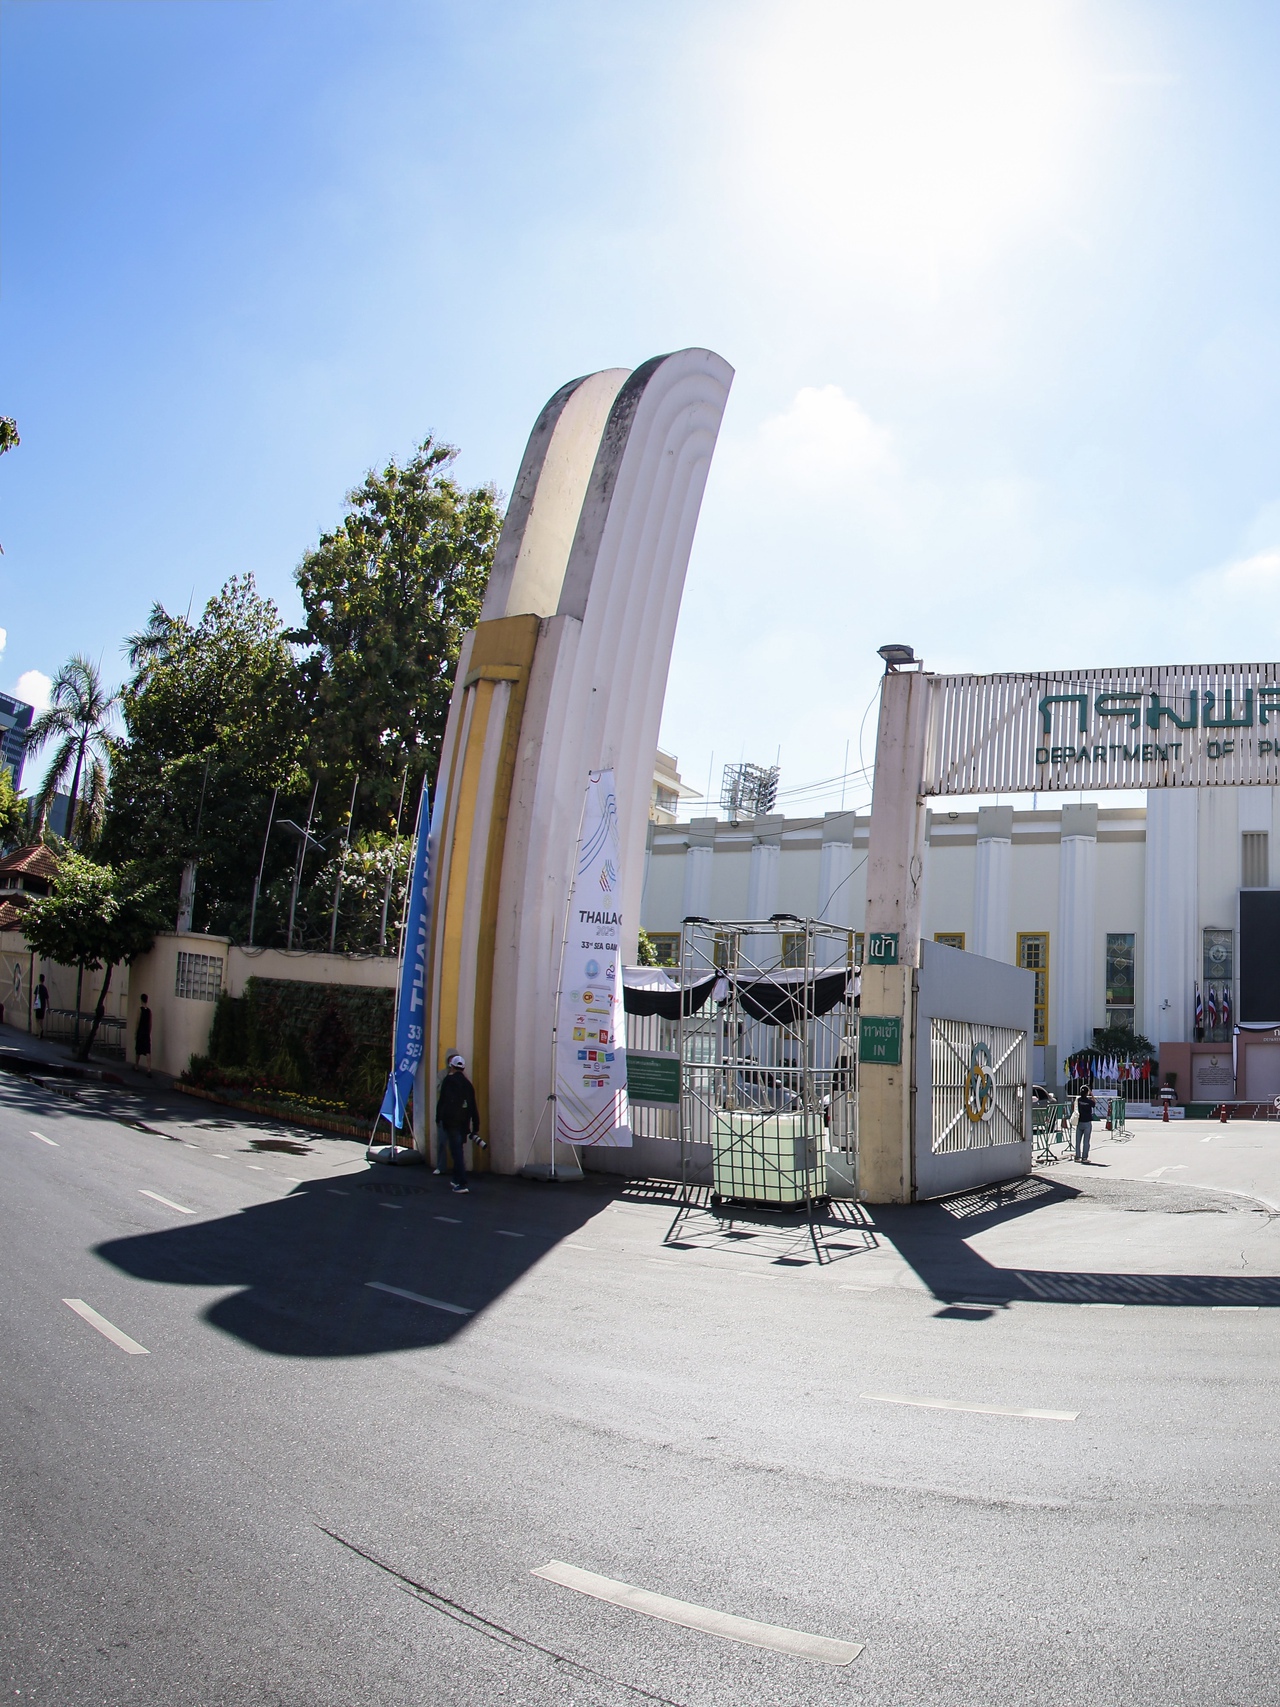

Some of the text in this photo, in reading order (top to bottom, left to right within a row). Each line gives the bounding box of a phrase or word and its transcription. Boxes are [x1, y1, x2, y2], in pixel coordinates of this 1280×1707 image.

[1036, 742, 1182, 764] DEPARTMENT
[1207, 740, 1235, 759] OF
[594, 942, 604, 950] SEA
[870, 934, 895, 957] เข้า
[873, 1045, 886, 1056] IN
